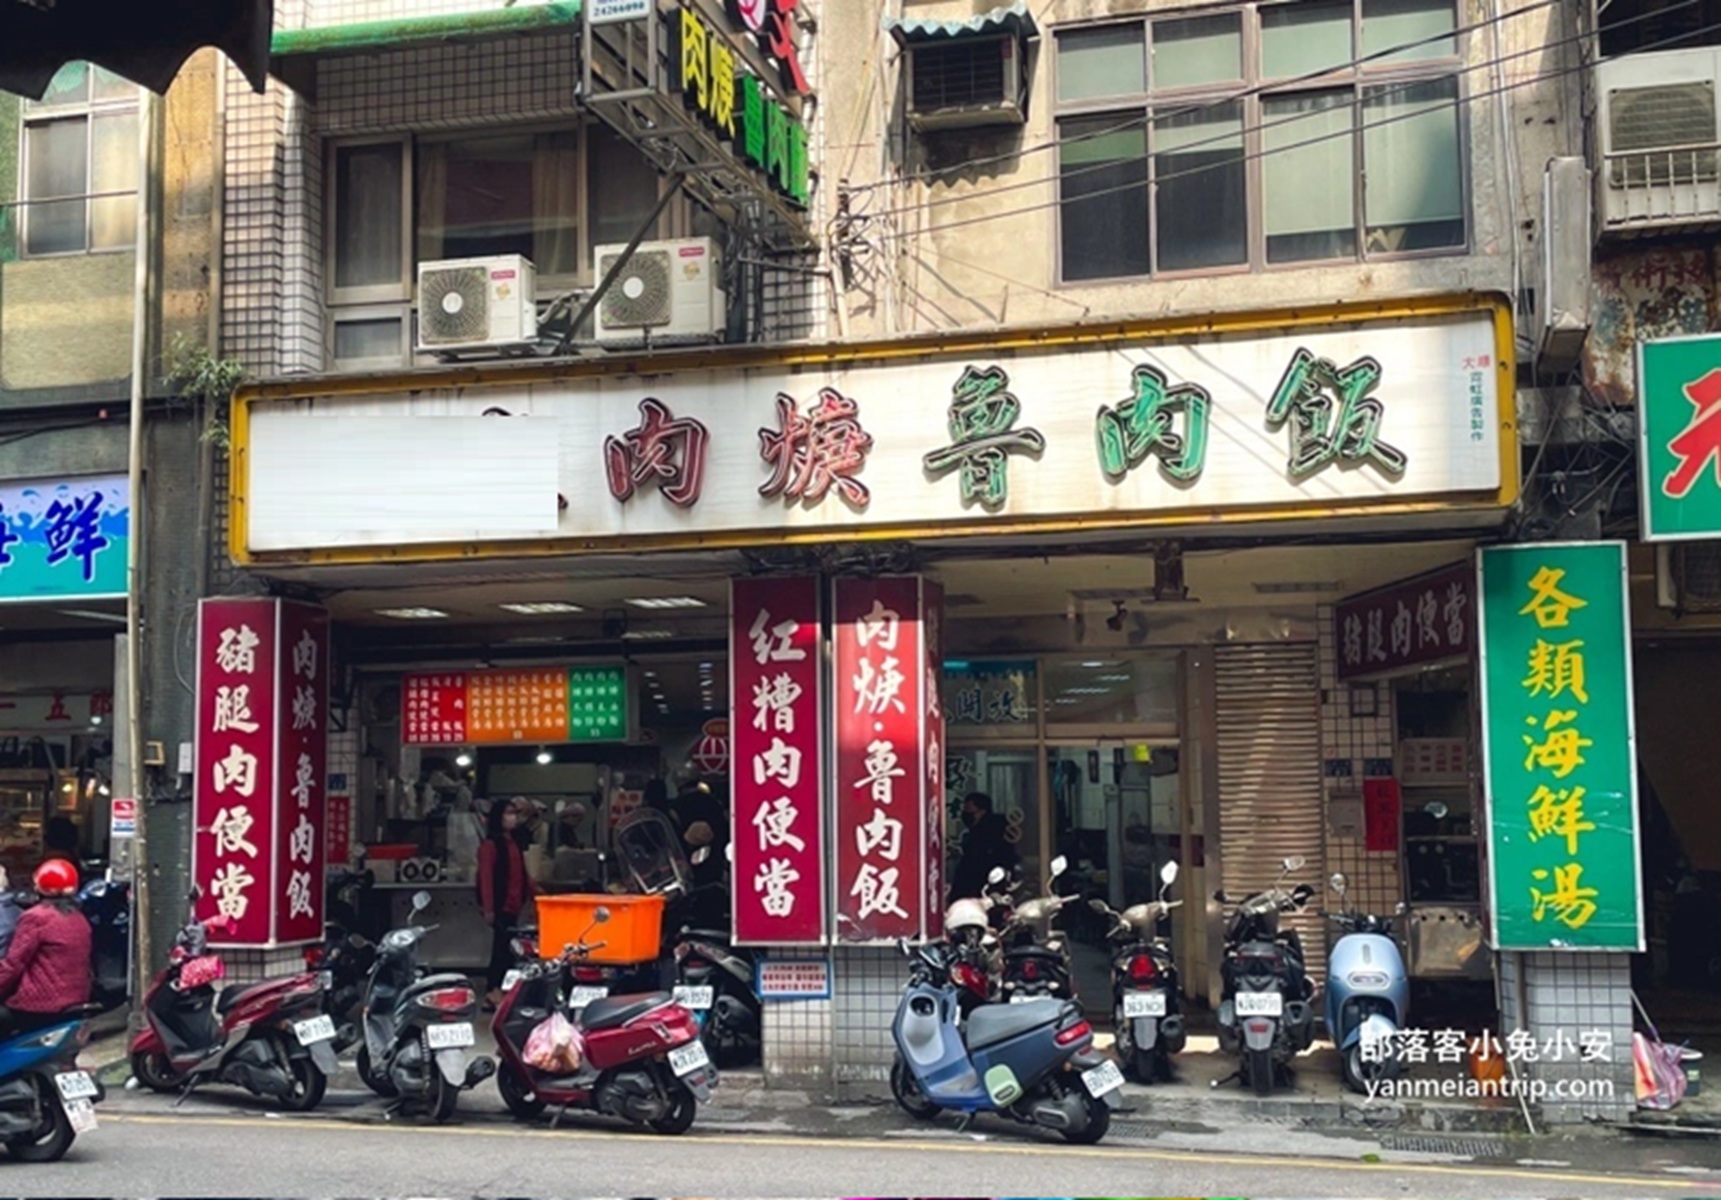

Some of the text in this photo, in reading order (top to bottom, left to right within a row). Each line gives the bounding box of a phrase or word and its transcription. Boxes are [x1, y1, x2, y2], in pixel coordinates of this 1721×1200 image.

[210, 624, 261, 920] 豬腿肉便當
[748, 607, 806, 918] 紅糟肉便當
[1519, 565, 1599, 930] 各類海鮮湯
